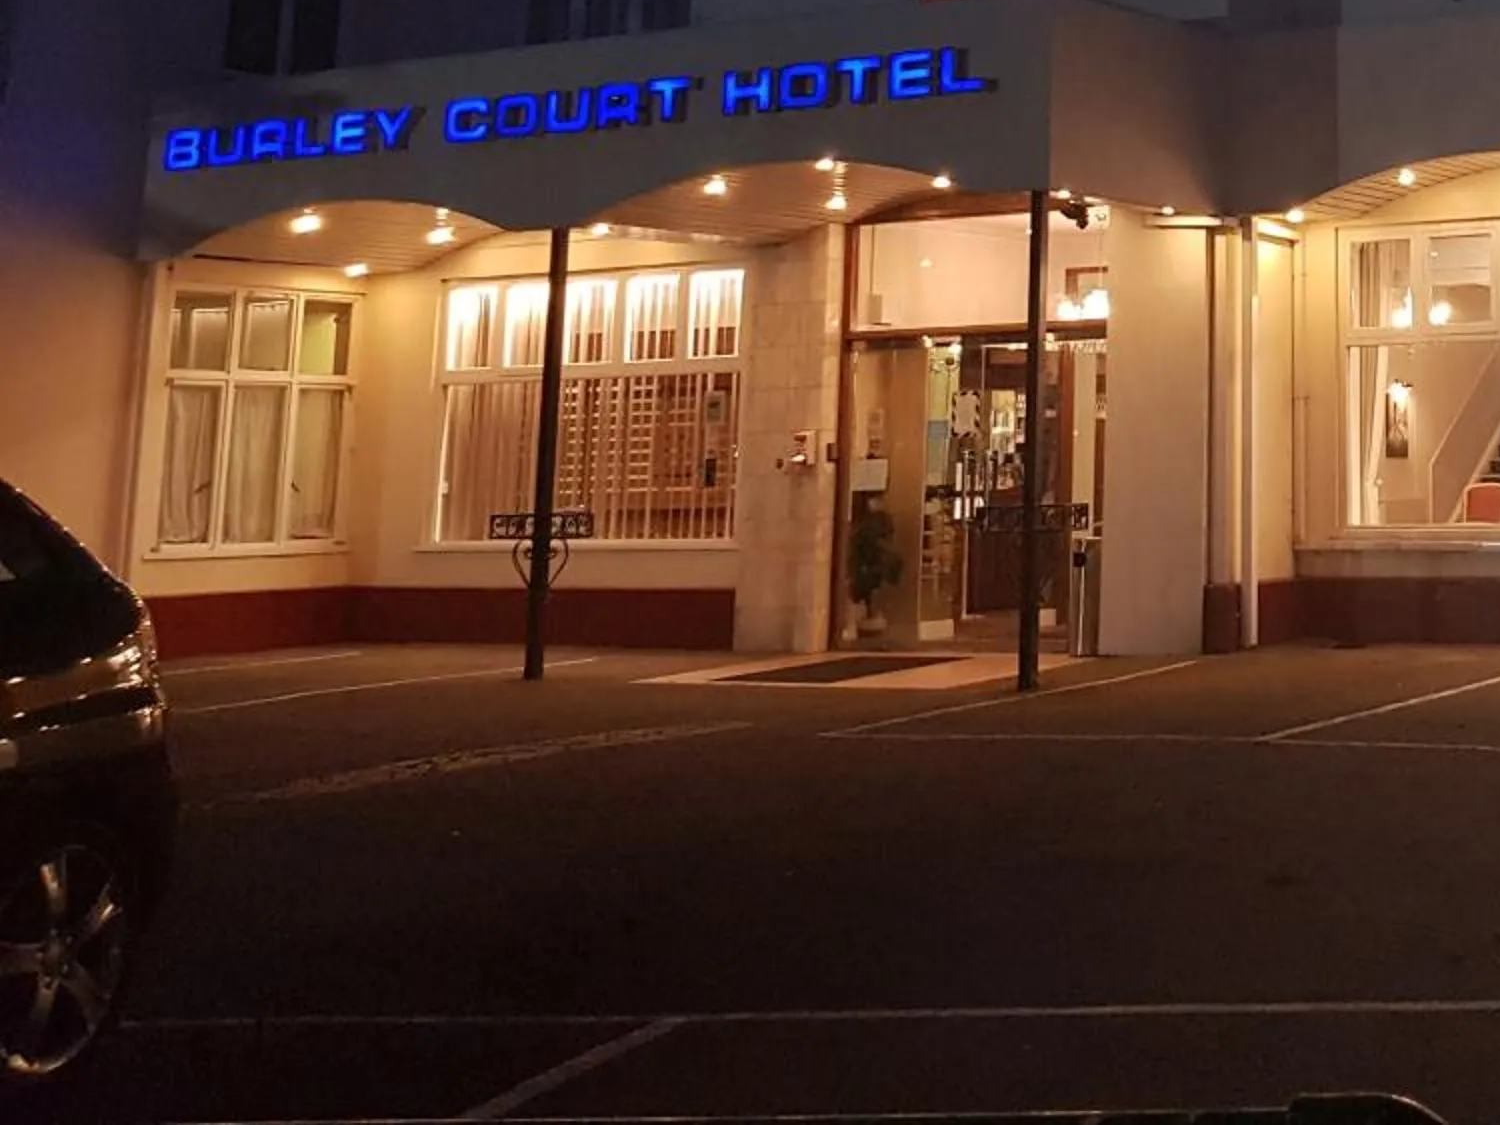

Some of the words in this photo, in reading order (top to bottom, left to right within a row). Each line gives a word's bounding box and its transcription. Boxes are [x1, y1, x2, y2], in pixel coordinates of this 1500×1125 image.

[162, 106, 411, 172] BURLEY
[443, 76, 692, 143] COURT
[721, 49, 985, 115] HOTEL
